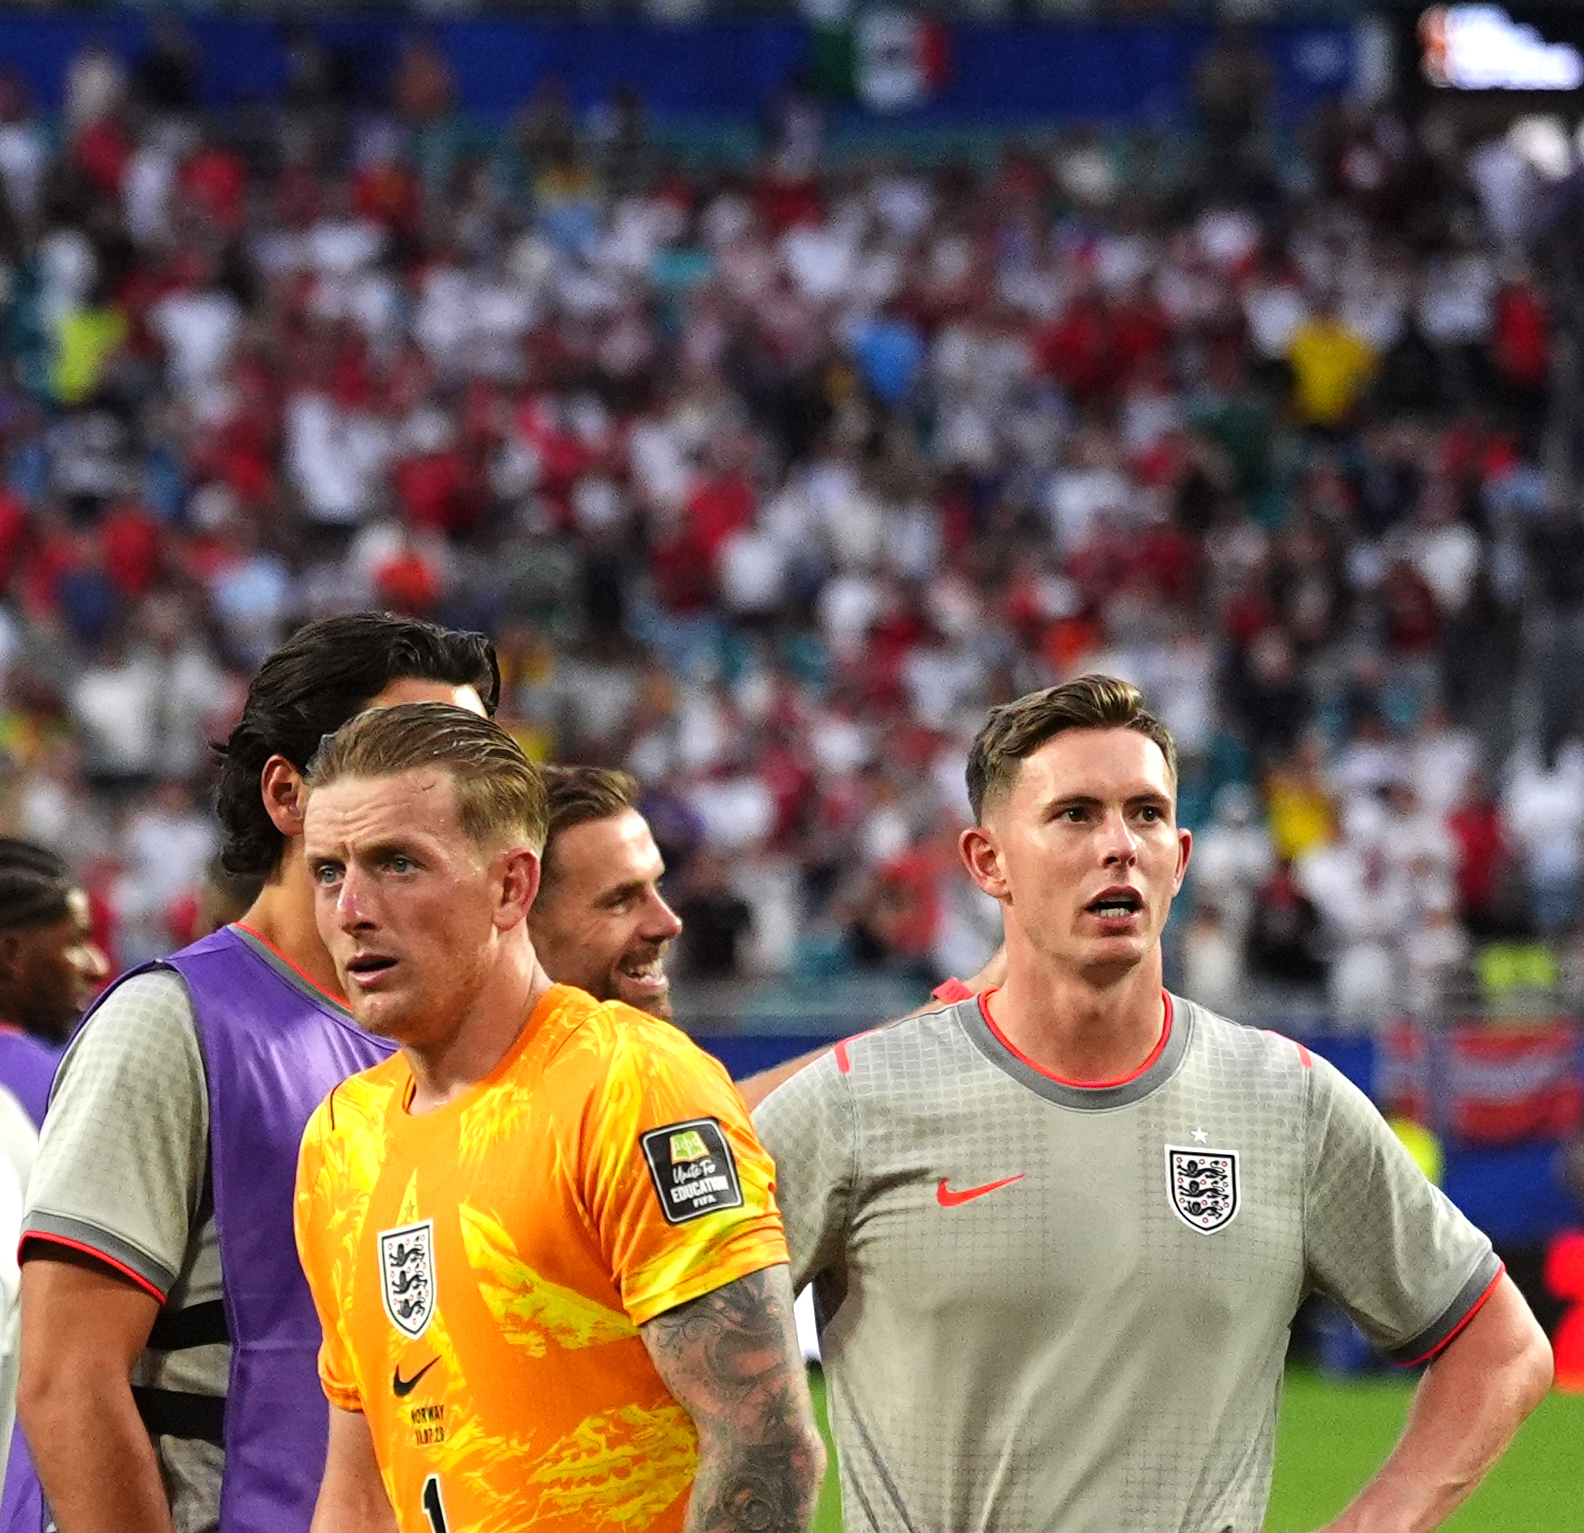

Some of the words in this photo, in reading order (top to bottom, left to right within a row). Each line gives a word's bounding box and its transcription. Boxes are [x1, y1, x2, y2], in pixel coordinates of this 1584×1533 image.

[670, 1174, 730, 1204] EDUCATION
[692, 1193, 718, 1208] FIFA
[410, 1404, 445, 1425] NORWAY
